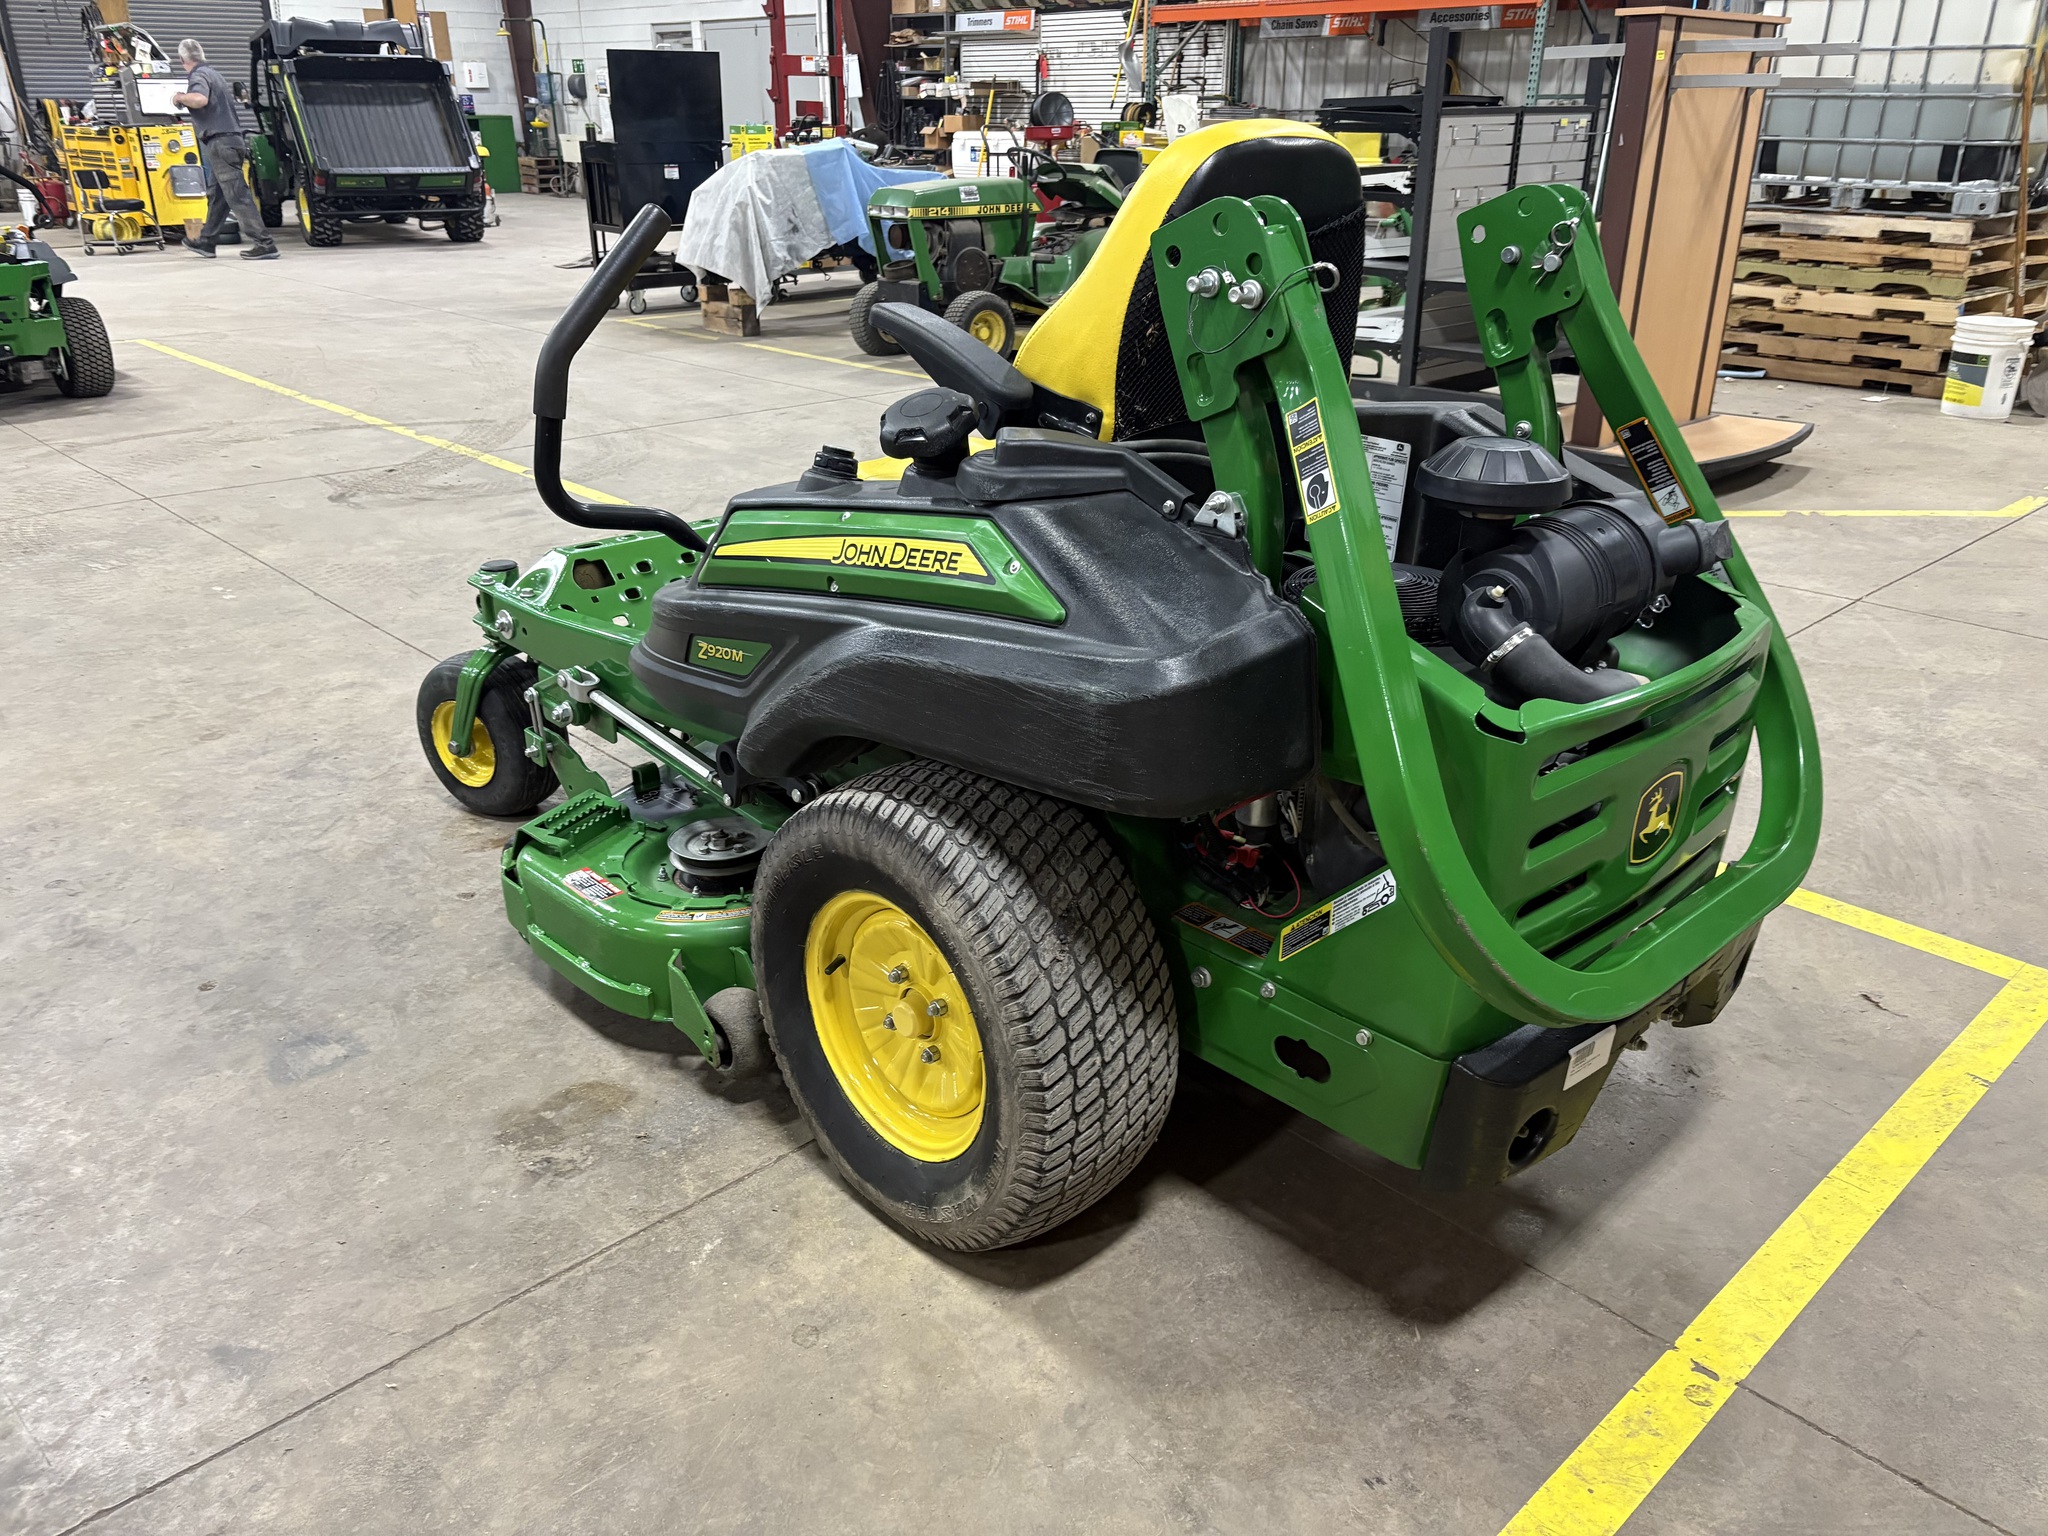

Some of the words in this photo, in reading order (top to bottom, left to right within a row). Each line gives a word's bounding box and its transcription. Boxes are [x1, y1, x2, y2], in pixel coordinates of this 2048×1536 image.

[967, 17, 993, 26] Trimmers
[1005, 15, 1029, 25] STIHL
[1271, 18, 1294, 30] Chain
[1295, 18, 1318, 29] Saws
[1331, 15, 1365, 28] STIHL
[1430, 11, 1490, 24] Accessories
[1503, 7, 1539, 21] STIH
[928, 207, 951, 216] 214
[977, 204, 1001, 214] JOHN
[1005, 203, 1033, 212] DEEE
[831, 539, 888, 565] JOHN
[888, 542, 963, 573] DEERE
[697, 641, 744, 663] Z920M
